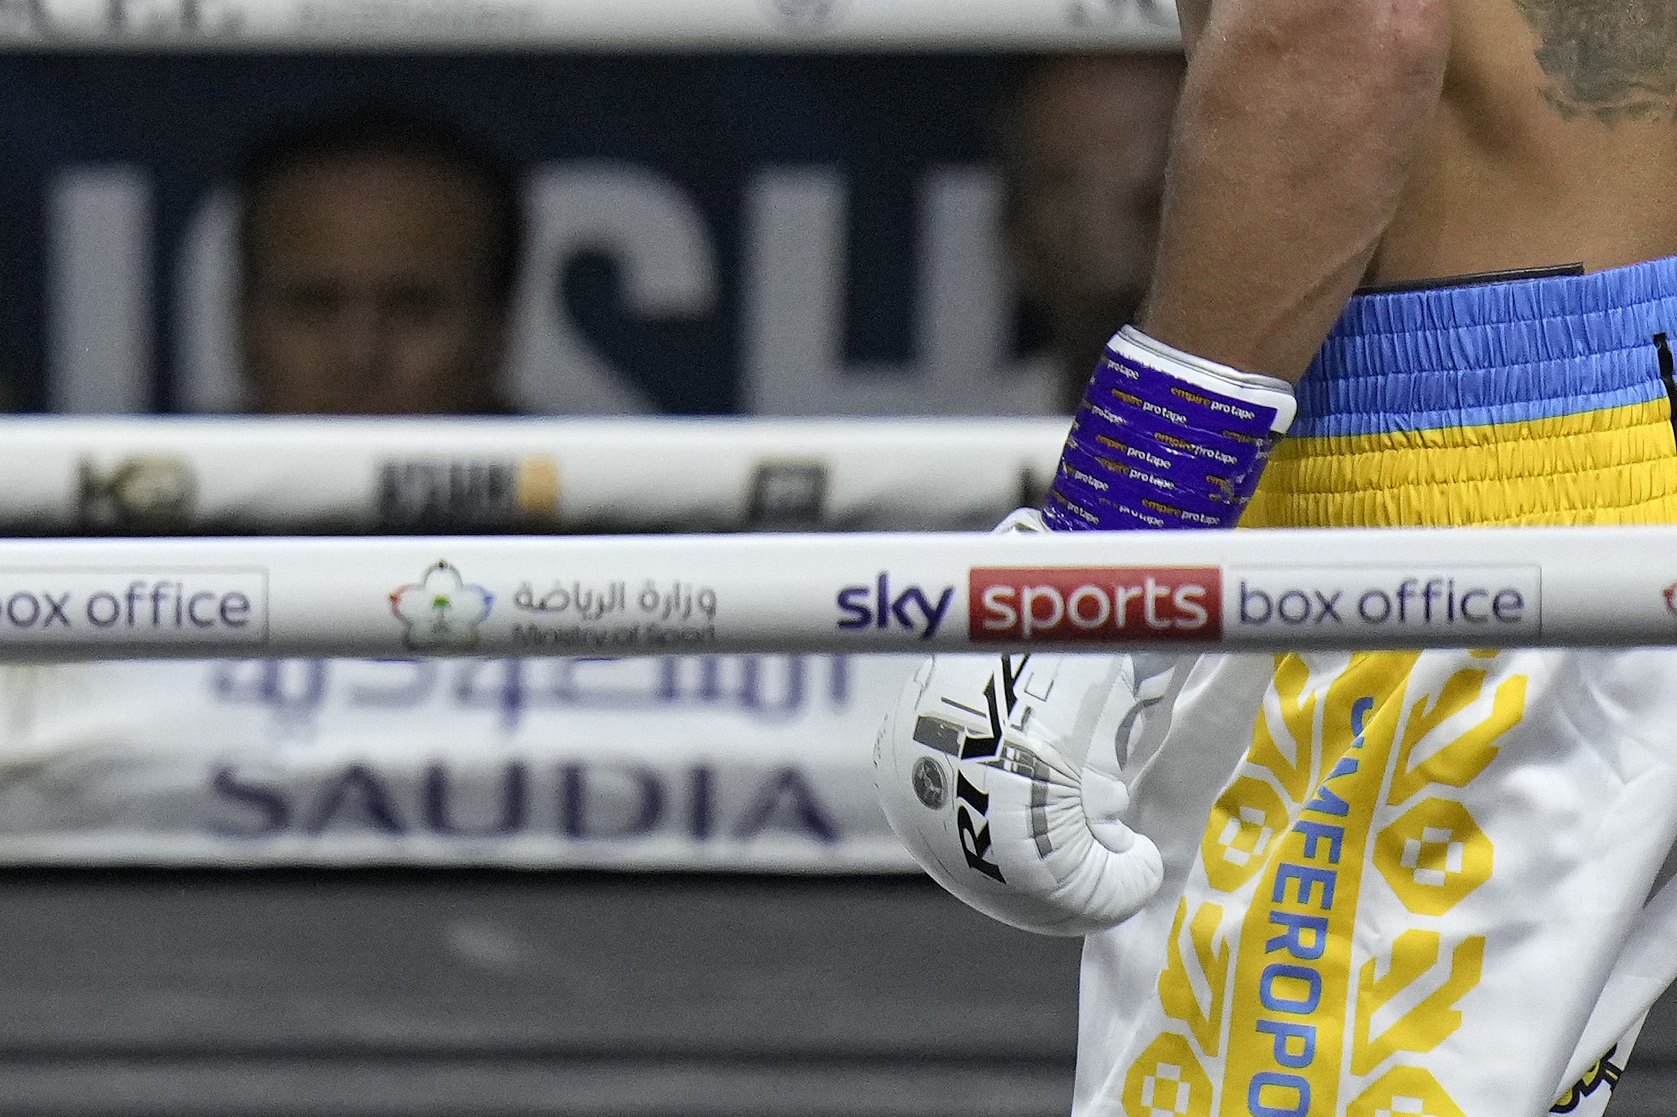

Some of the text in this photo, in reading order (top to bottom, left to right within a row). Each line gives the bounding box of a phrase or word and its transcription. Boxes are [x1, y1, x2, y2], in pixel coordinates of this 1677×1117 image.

[85, 580, 252, 630] office
[638, 578, 718, 622] وزارة
[835, 572, 1526, 641] sky sports box office
[204, 762, 848, 848] SAUDIA
